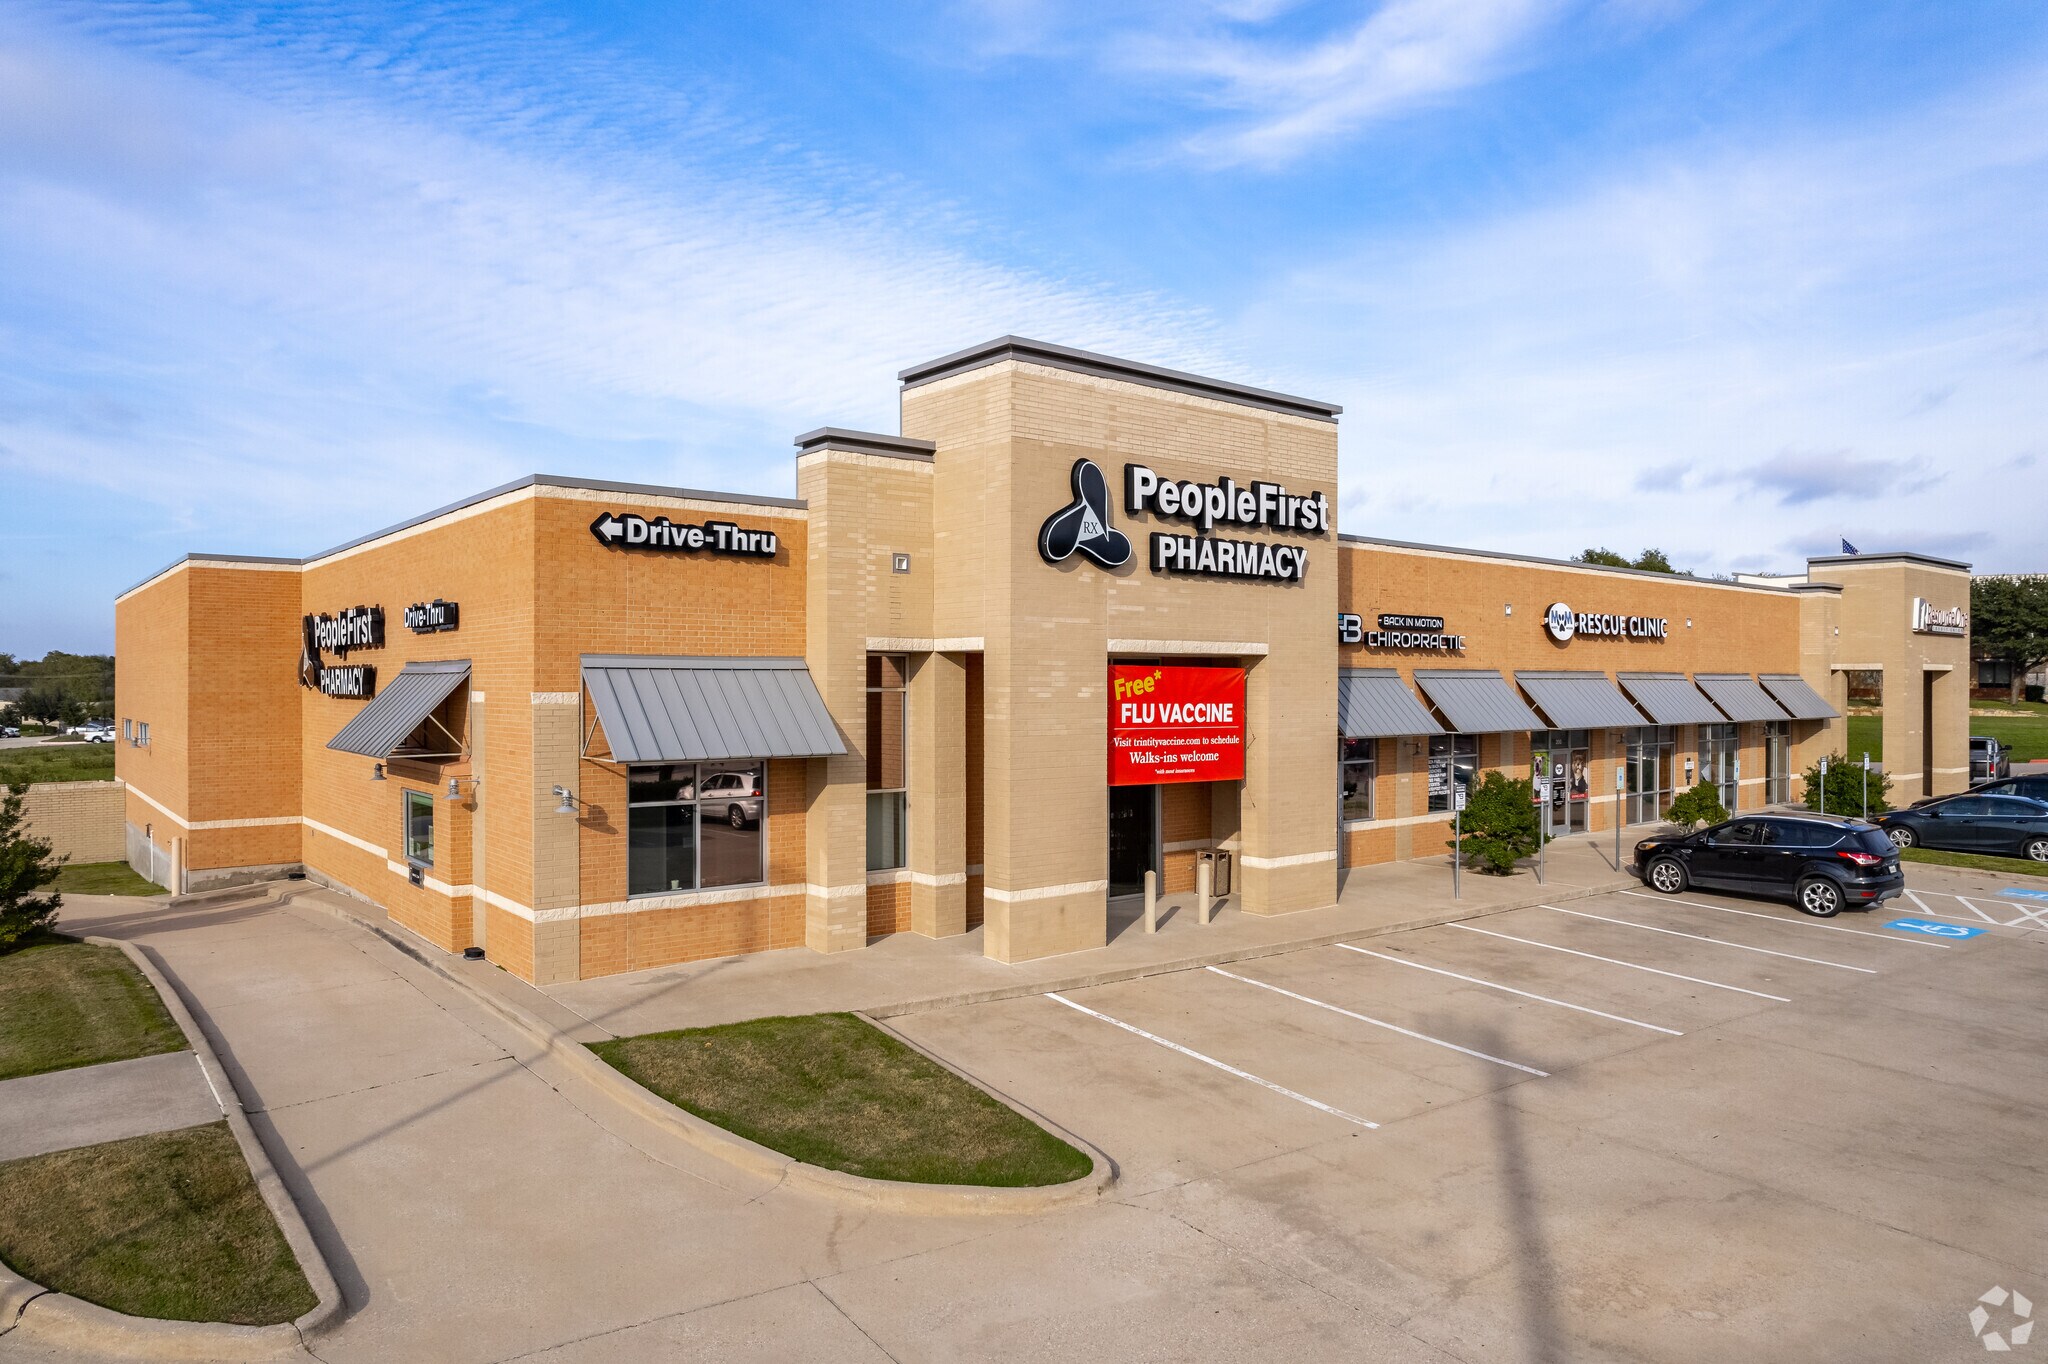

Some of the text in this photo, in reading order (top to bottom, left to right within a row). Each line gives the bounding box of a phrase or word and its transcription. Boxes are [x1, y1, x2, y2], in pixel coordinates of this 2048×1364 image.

[1132, 466, 1329, 531] PeopleFirst
[627, 517, 777, 553] Drive-Thru
[1083, 521, 1098, 535] RX
[1158, 536, 1308, 578] PHARMACY
[404, 603, 445, 628] Drive-Thru
[1384, 616, 1443, 628] BACK IN MOTION
[1579, 613, 1668, 638] RESCUE CLINIC
[314, 608, 373, 655] PeopleFirst
[1368, 631, 1466, 650] CHIROPRACTIC
[320, 667, 364, 695] PHARMACY
[1121, 703, 1233, 724] FLU VACCINE
[1113, 737, 1132, 747] Visit
[1202, 736, 1210, 745] to
[1210, 734, 1240, 745] schedule
[1129, 750, 1220, 764] Walks-ins welcome
